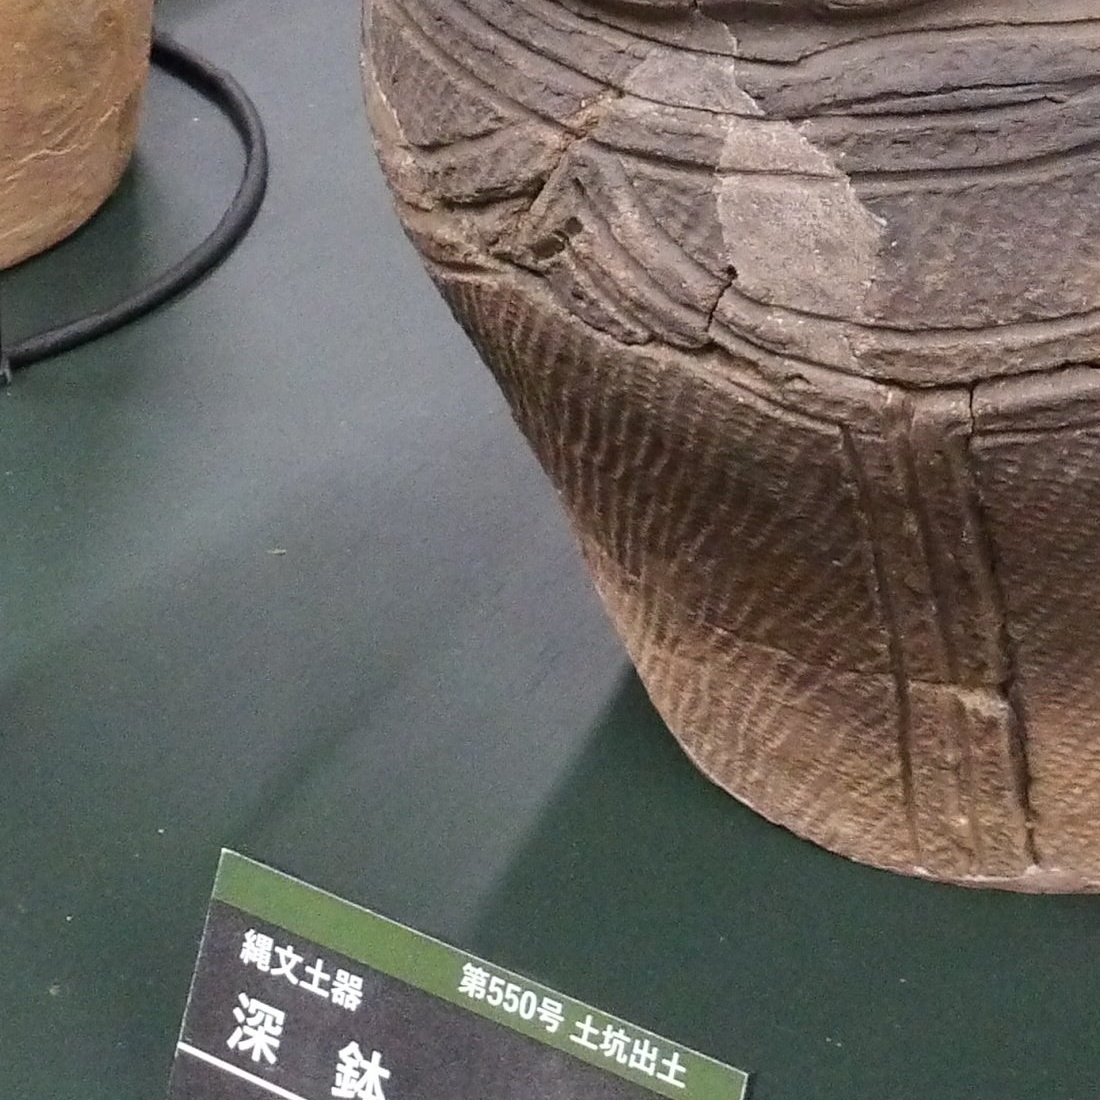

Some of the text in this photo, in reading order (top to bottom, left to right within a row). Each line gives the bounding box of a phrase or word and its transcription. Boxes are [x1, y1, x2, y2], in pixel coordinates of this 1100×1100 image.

[239, 928, 364, 1012] 縄文土器
[457, 962, 687, 1089] 第550号 土坑出土
